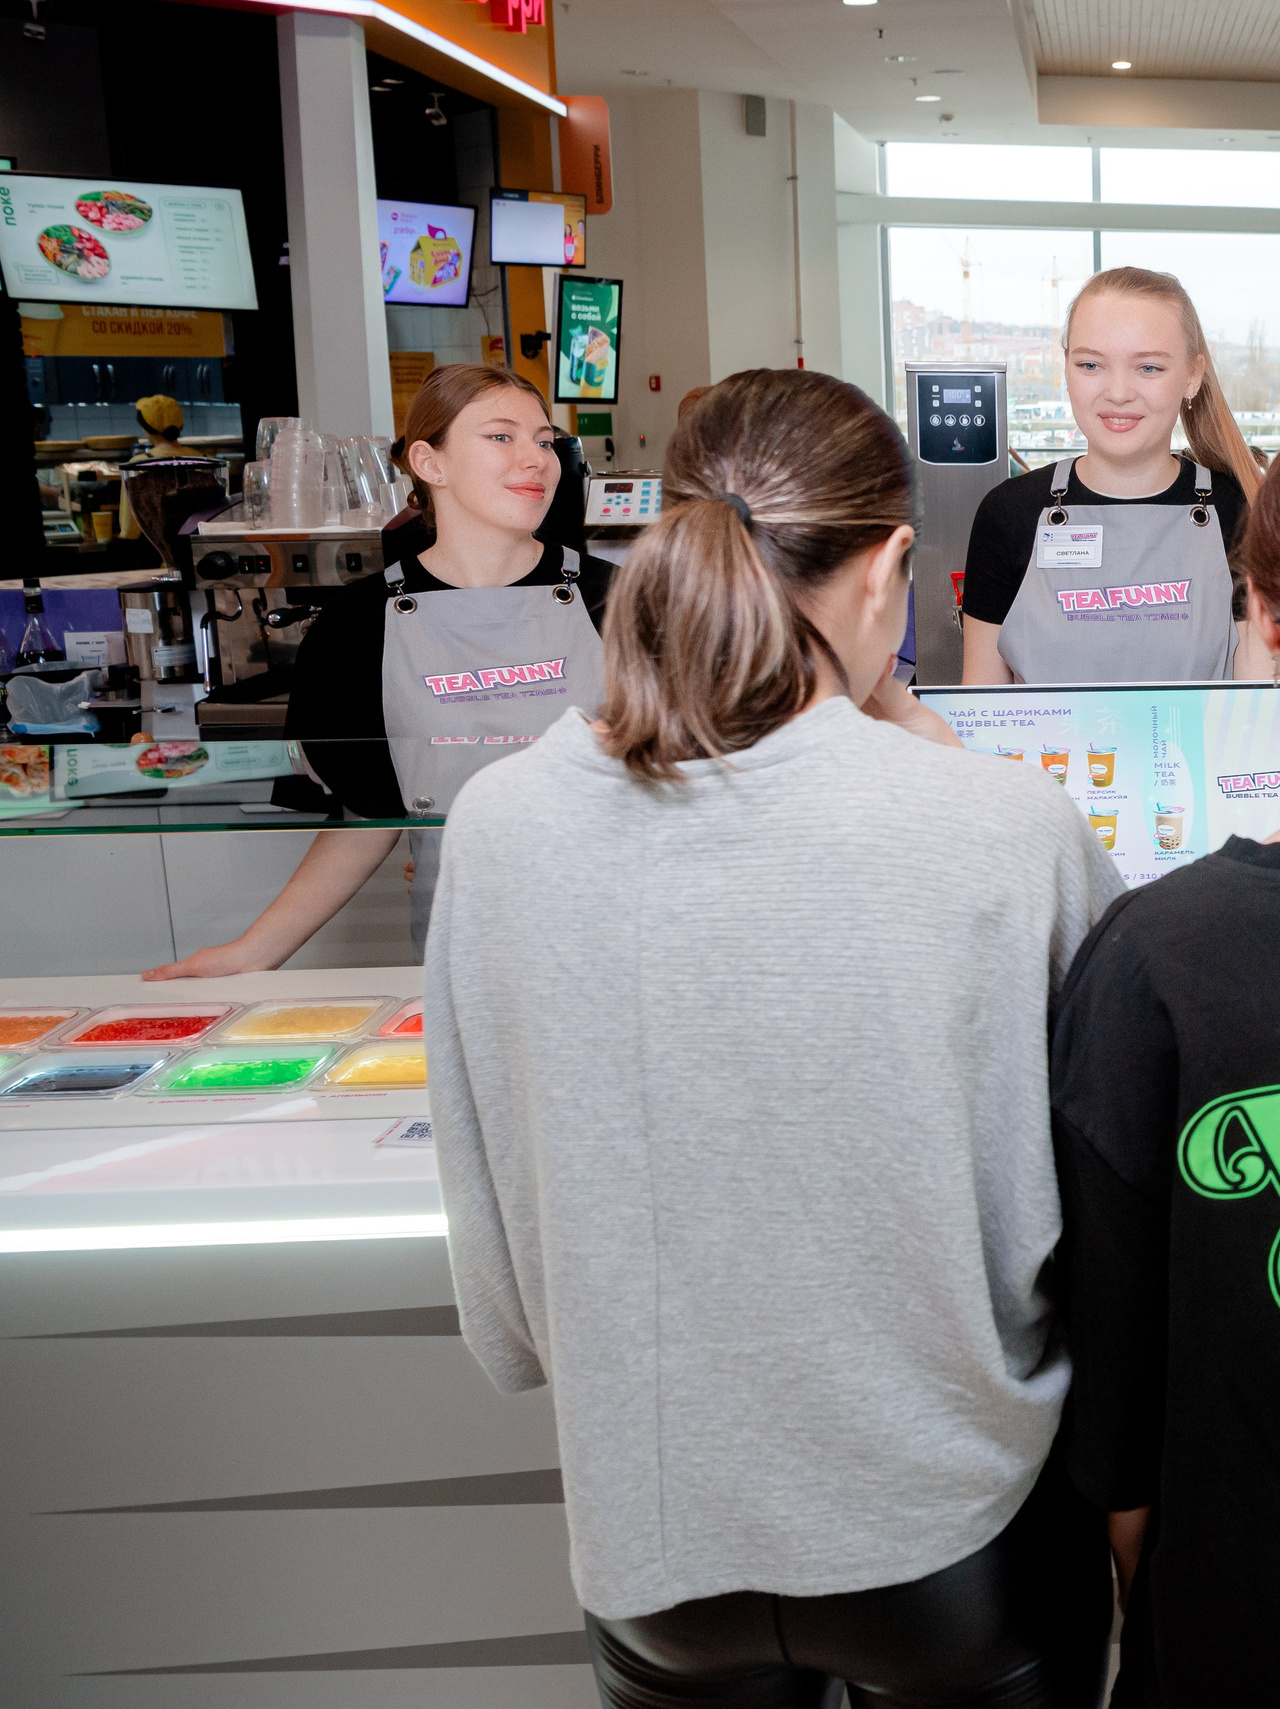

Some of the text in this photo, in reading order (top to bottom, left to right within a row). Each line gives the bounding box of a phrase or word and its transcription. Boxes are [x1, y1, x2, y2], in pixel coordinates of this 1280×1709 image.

[92, 320, 193, 336] СО СКИДКОЙ 20%
[1056, 579, 1191, 613] TEA FUNNY
[424, 658, 565, 696] TEA FUNNY
[948, 708, 977, 718] ЧАЙ
[992, 708, 1072, 718] ШАРИКАМИ
[956, 720, 1007, 728] BUBBLE
[1011, 719, 1036, 727] TEA
[1151, 705, 1159, 759] МОЛОЧНЫЙ
[1219, 776, 1255, 792] TEA
